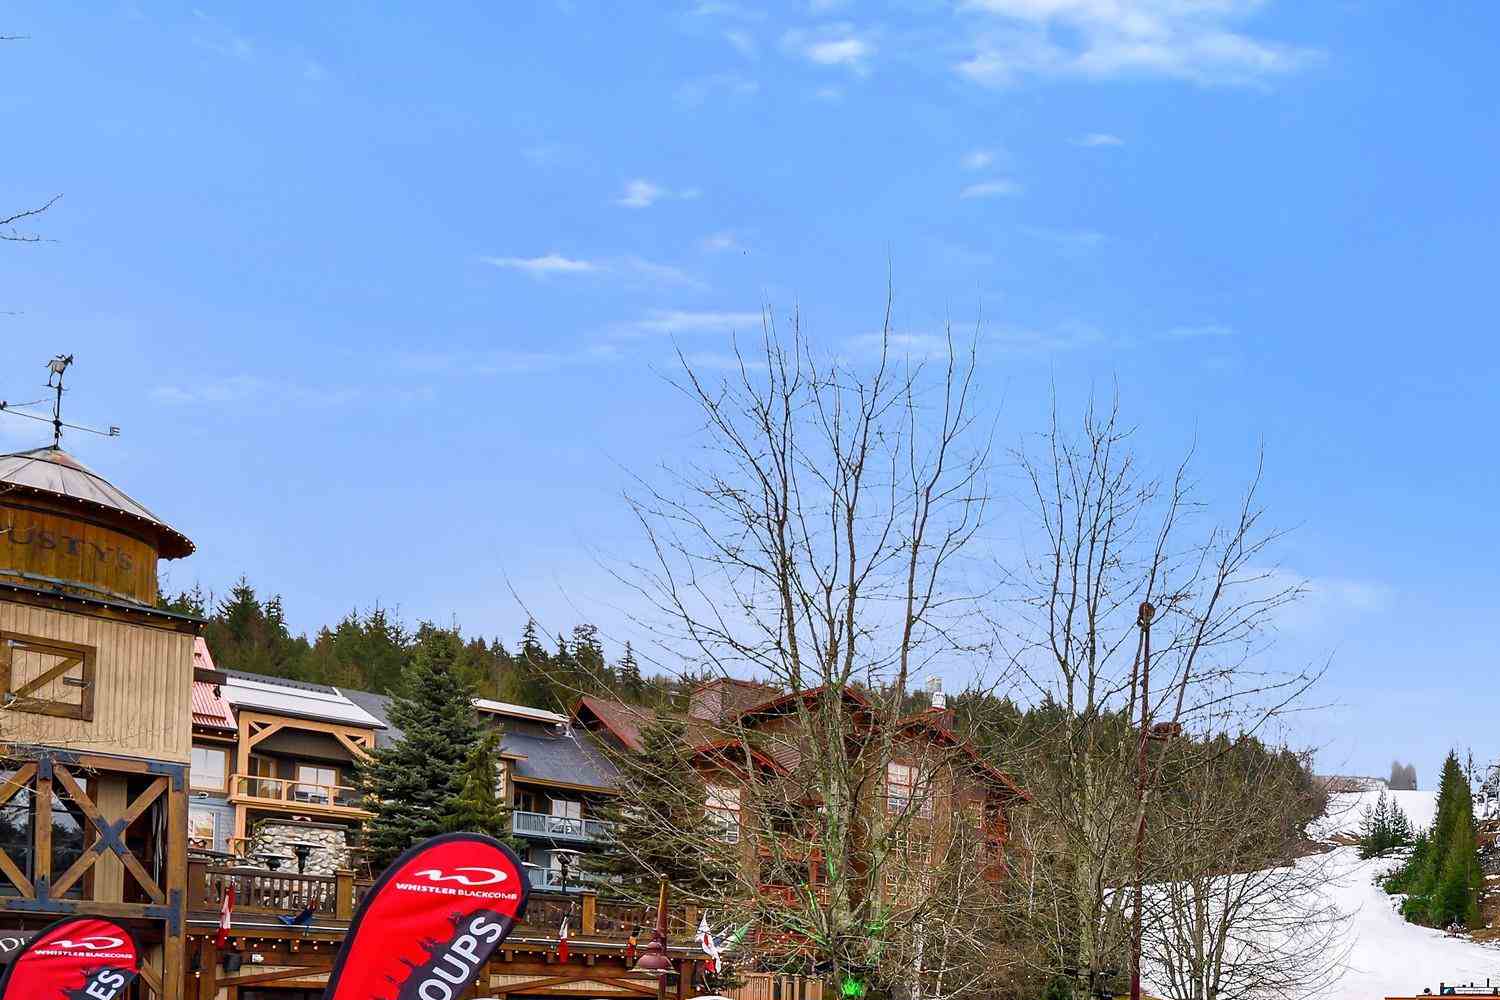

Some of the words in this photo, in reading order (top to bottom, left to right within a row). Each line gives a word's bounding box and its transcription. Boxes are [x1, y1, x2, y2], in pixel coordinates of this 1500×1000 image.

[7, 526, 134, 574] USTY'S
[395, 883, 457, 896] WHISTLER
[458, 890, 517, 900] BLACKCOMB
[34, 949, 85, 957] WHISTLER
